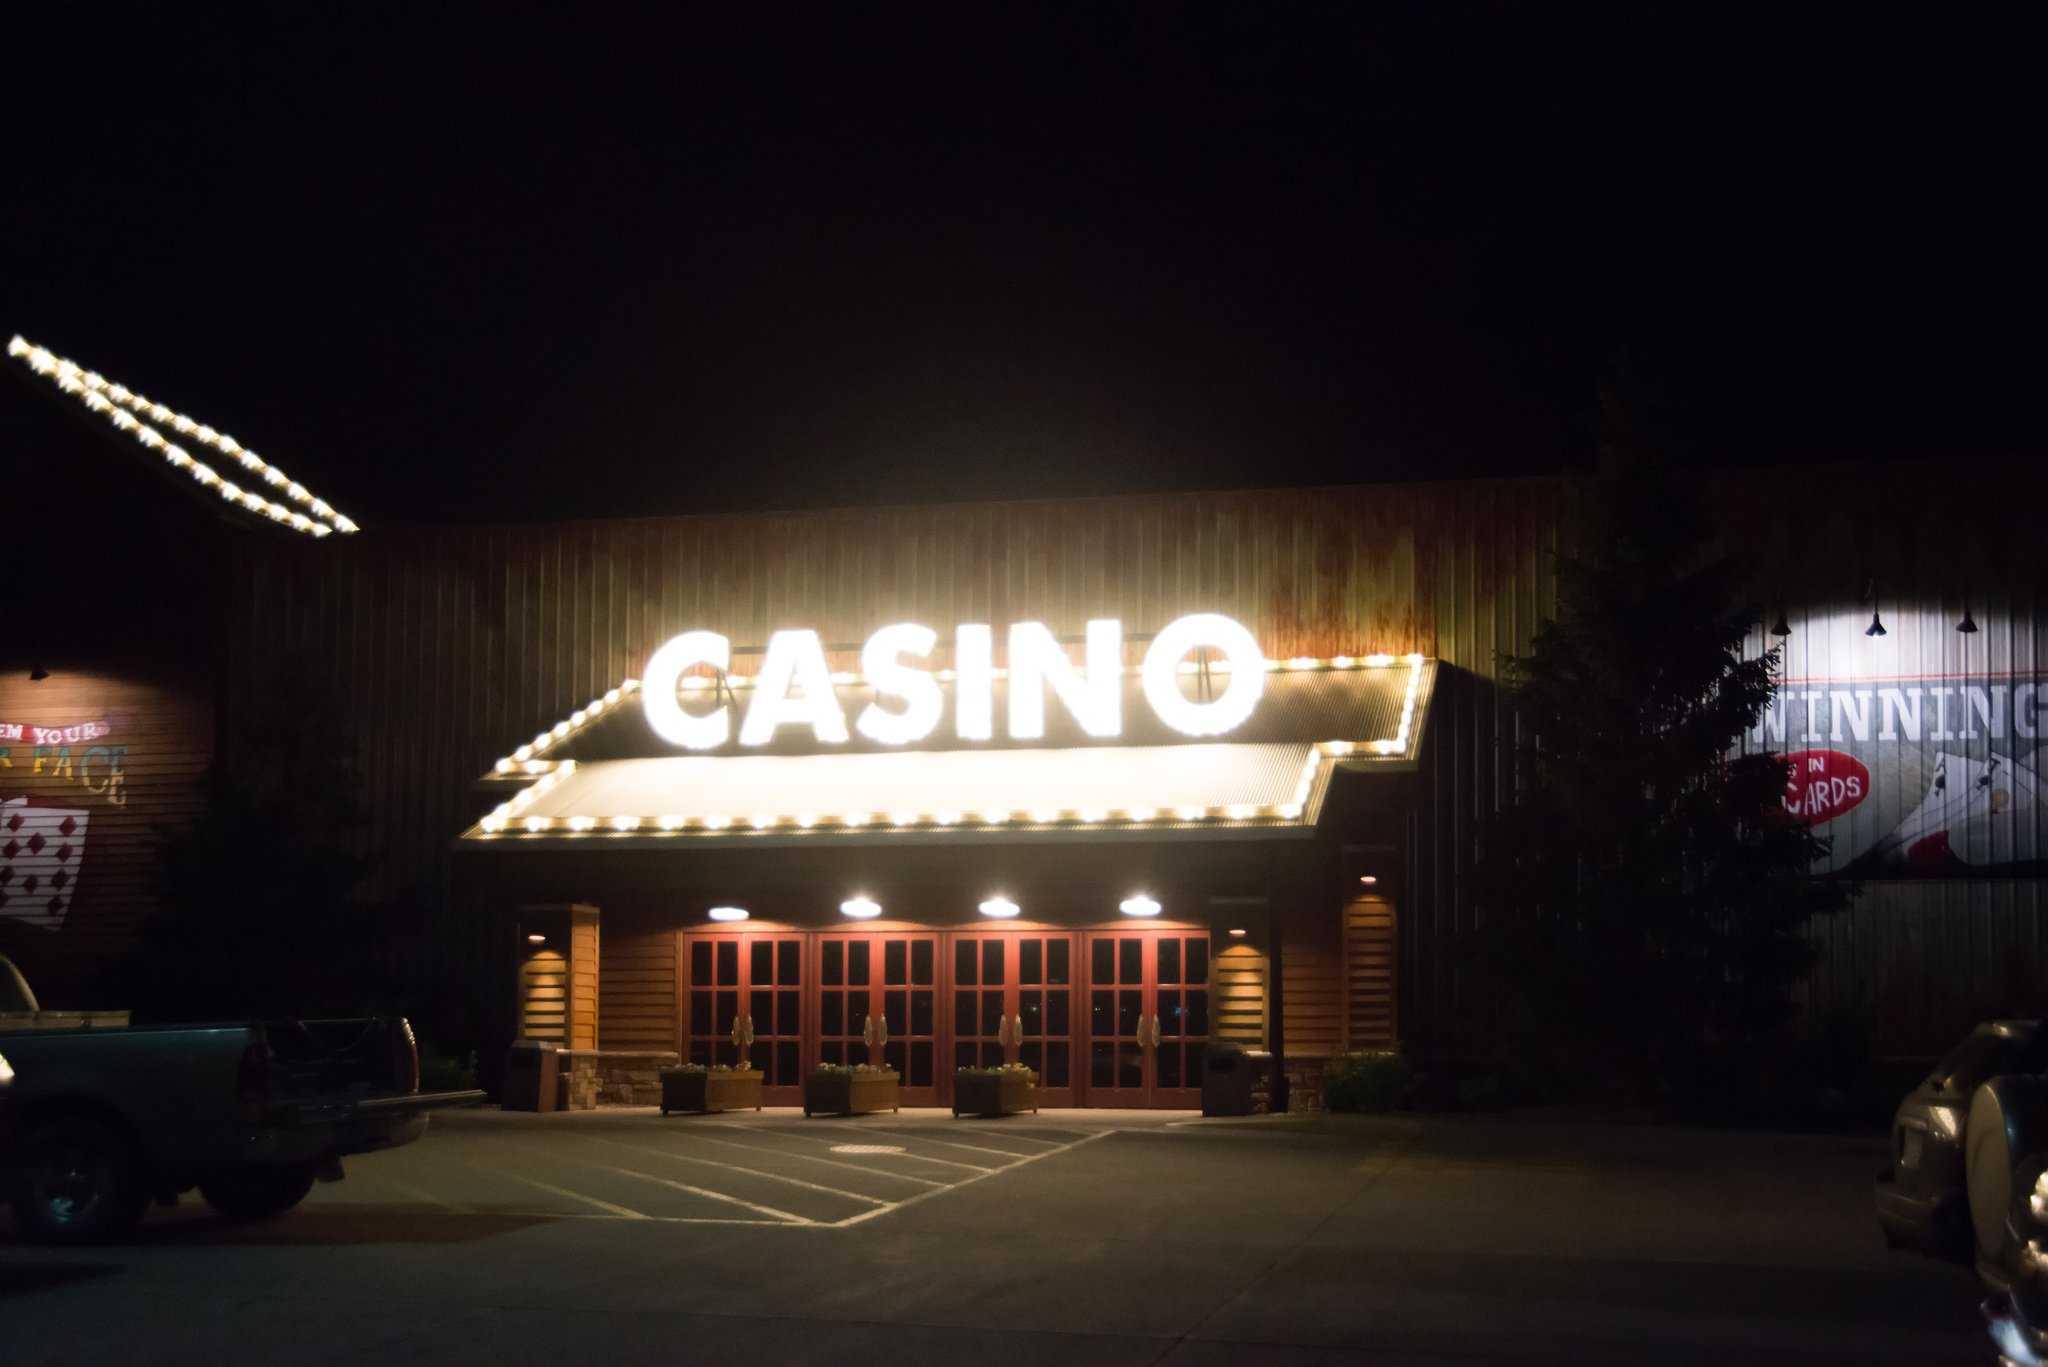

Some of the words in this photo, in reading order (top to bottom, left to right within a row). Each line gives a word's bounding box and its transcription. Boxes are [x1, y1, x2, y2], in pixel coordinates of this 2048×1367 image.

[641, 613, 1267, 750] CASINO
[32, 722, 98, 745] YOUR
[33, 745, 129, 808] FACE
[1807, 756, 1825, 773] IN
